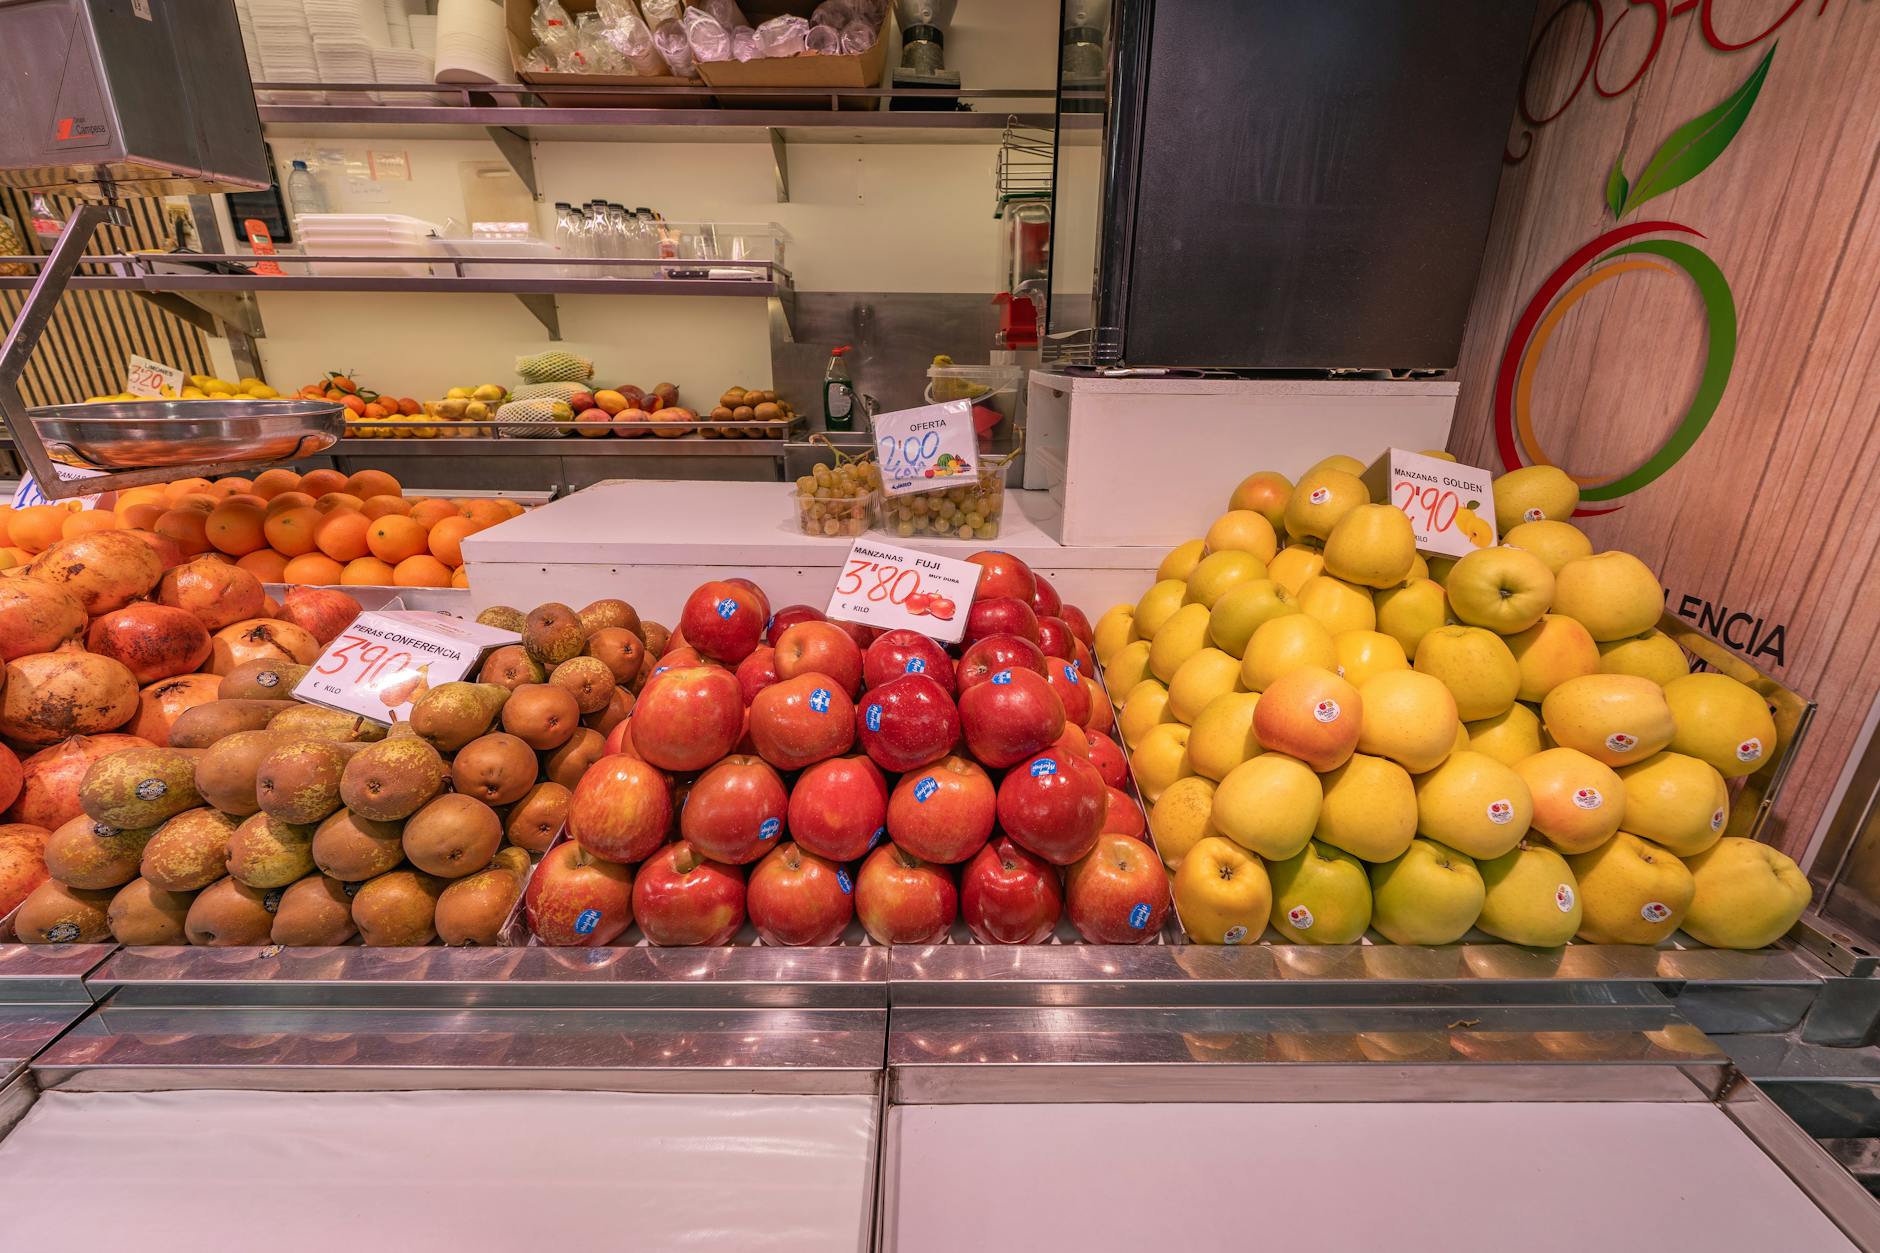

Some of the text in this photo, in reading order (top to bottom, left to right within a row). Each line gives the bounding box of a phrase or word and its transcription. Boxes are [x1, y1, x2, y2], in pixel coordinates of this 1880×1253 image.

[909, 419, 947, 432] OFERTA
[1394, 468, 1482, 493] MANZANAS GOLDEN
[854, 546, 941, 570] MANZANAS FUJI
[836, 559, 921, 605] 3'80
[852, 605, 870, 613] KILO
[353, 624, 462, 661] PERAS CONFERENCIA
[324, 685, 342, 695] KILO
